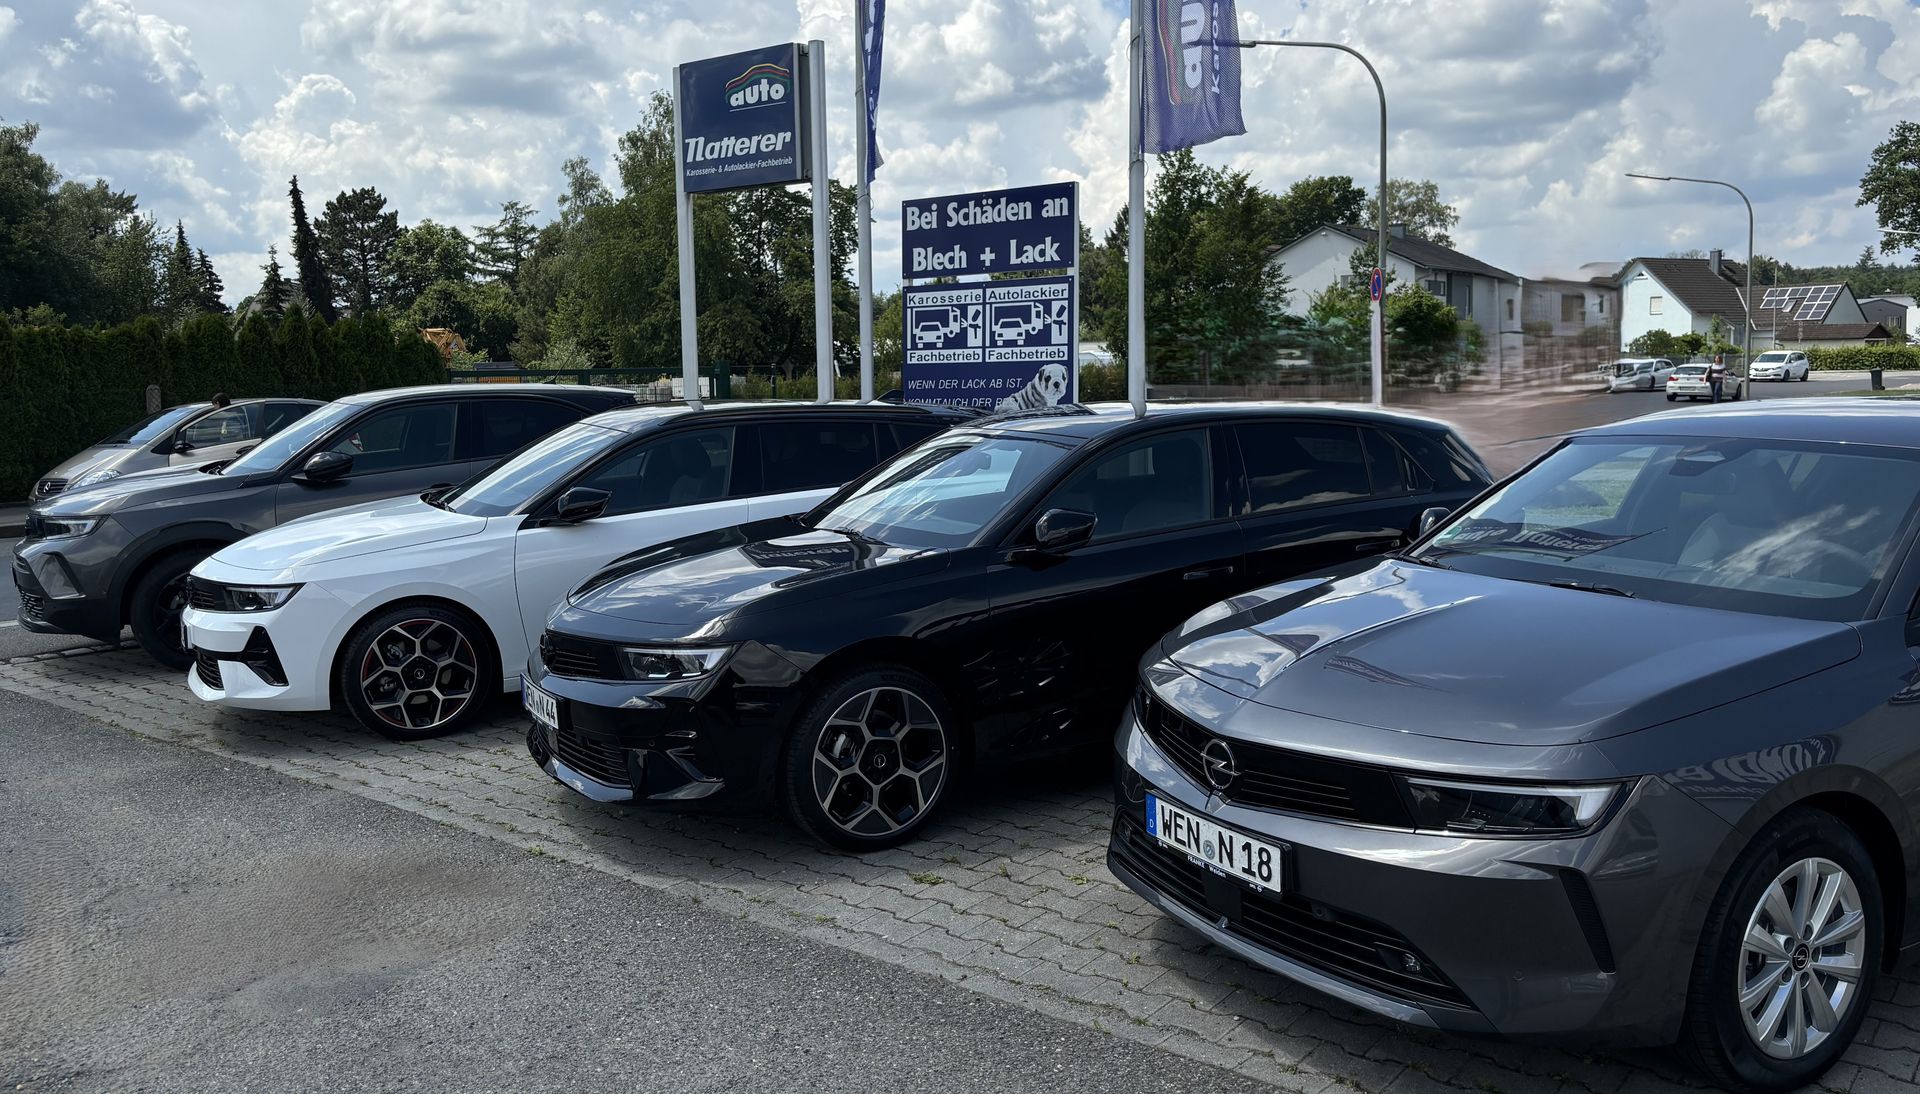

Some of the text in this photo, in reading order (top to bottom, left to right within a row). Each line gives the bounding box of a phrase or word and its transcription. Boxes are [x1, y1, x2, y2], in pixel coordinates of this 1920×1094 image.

[1180, 0, 1205, 89] au
[729, 78, 785, 107] auto
[686, 165, 717, 177] Karosserie-
[724, 157, 793, 173] Autolackier-Fachbetrieb
[906, 196, 1069, 231] Bei Schäden an
[912, 236, 1061, 272] Blech + Lack
[908, 291, 982, 306] Karosserie
[987, 286, 1067, 301] Autolackier
[909, 350, 980, 363] Fachbetrieb
[987, 347, 1065, 361] Fachbetrieb
[908, 377, 1023, 390] WENN DER LACK AB IST.
[1149, 804, 1273, 883] D WEN N 18
